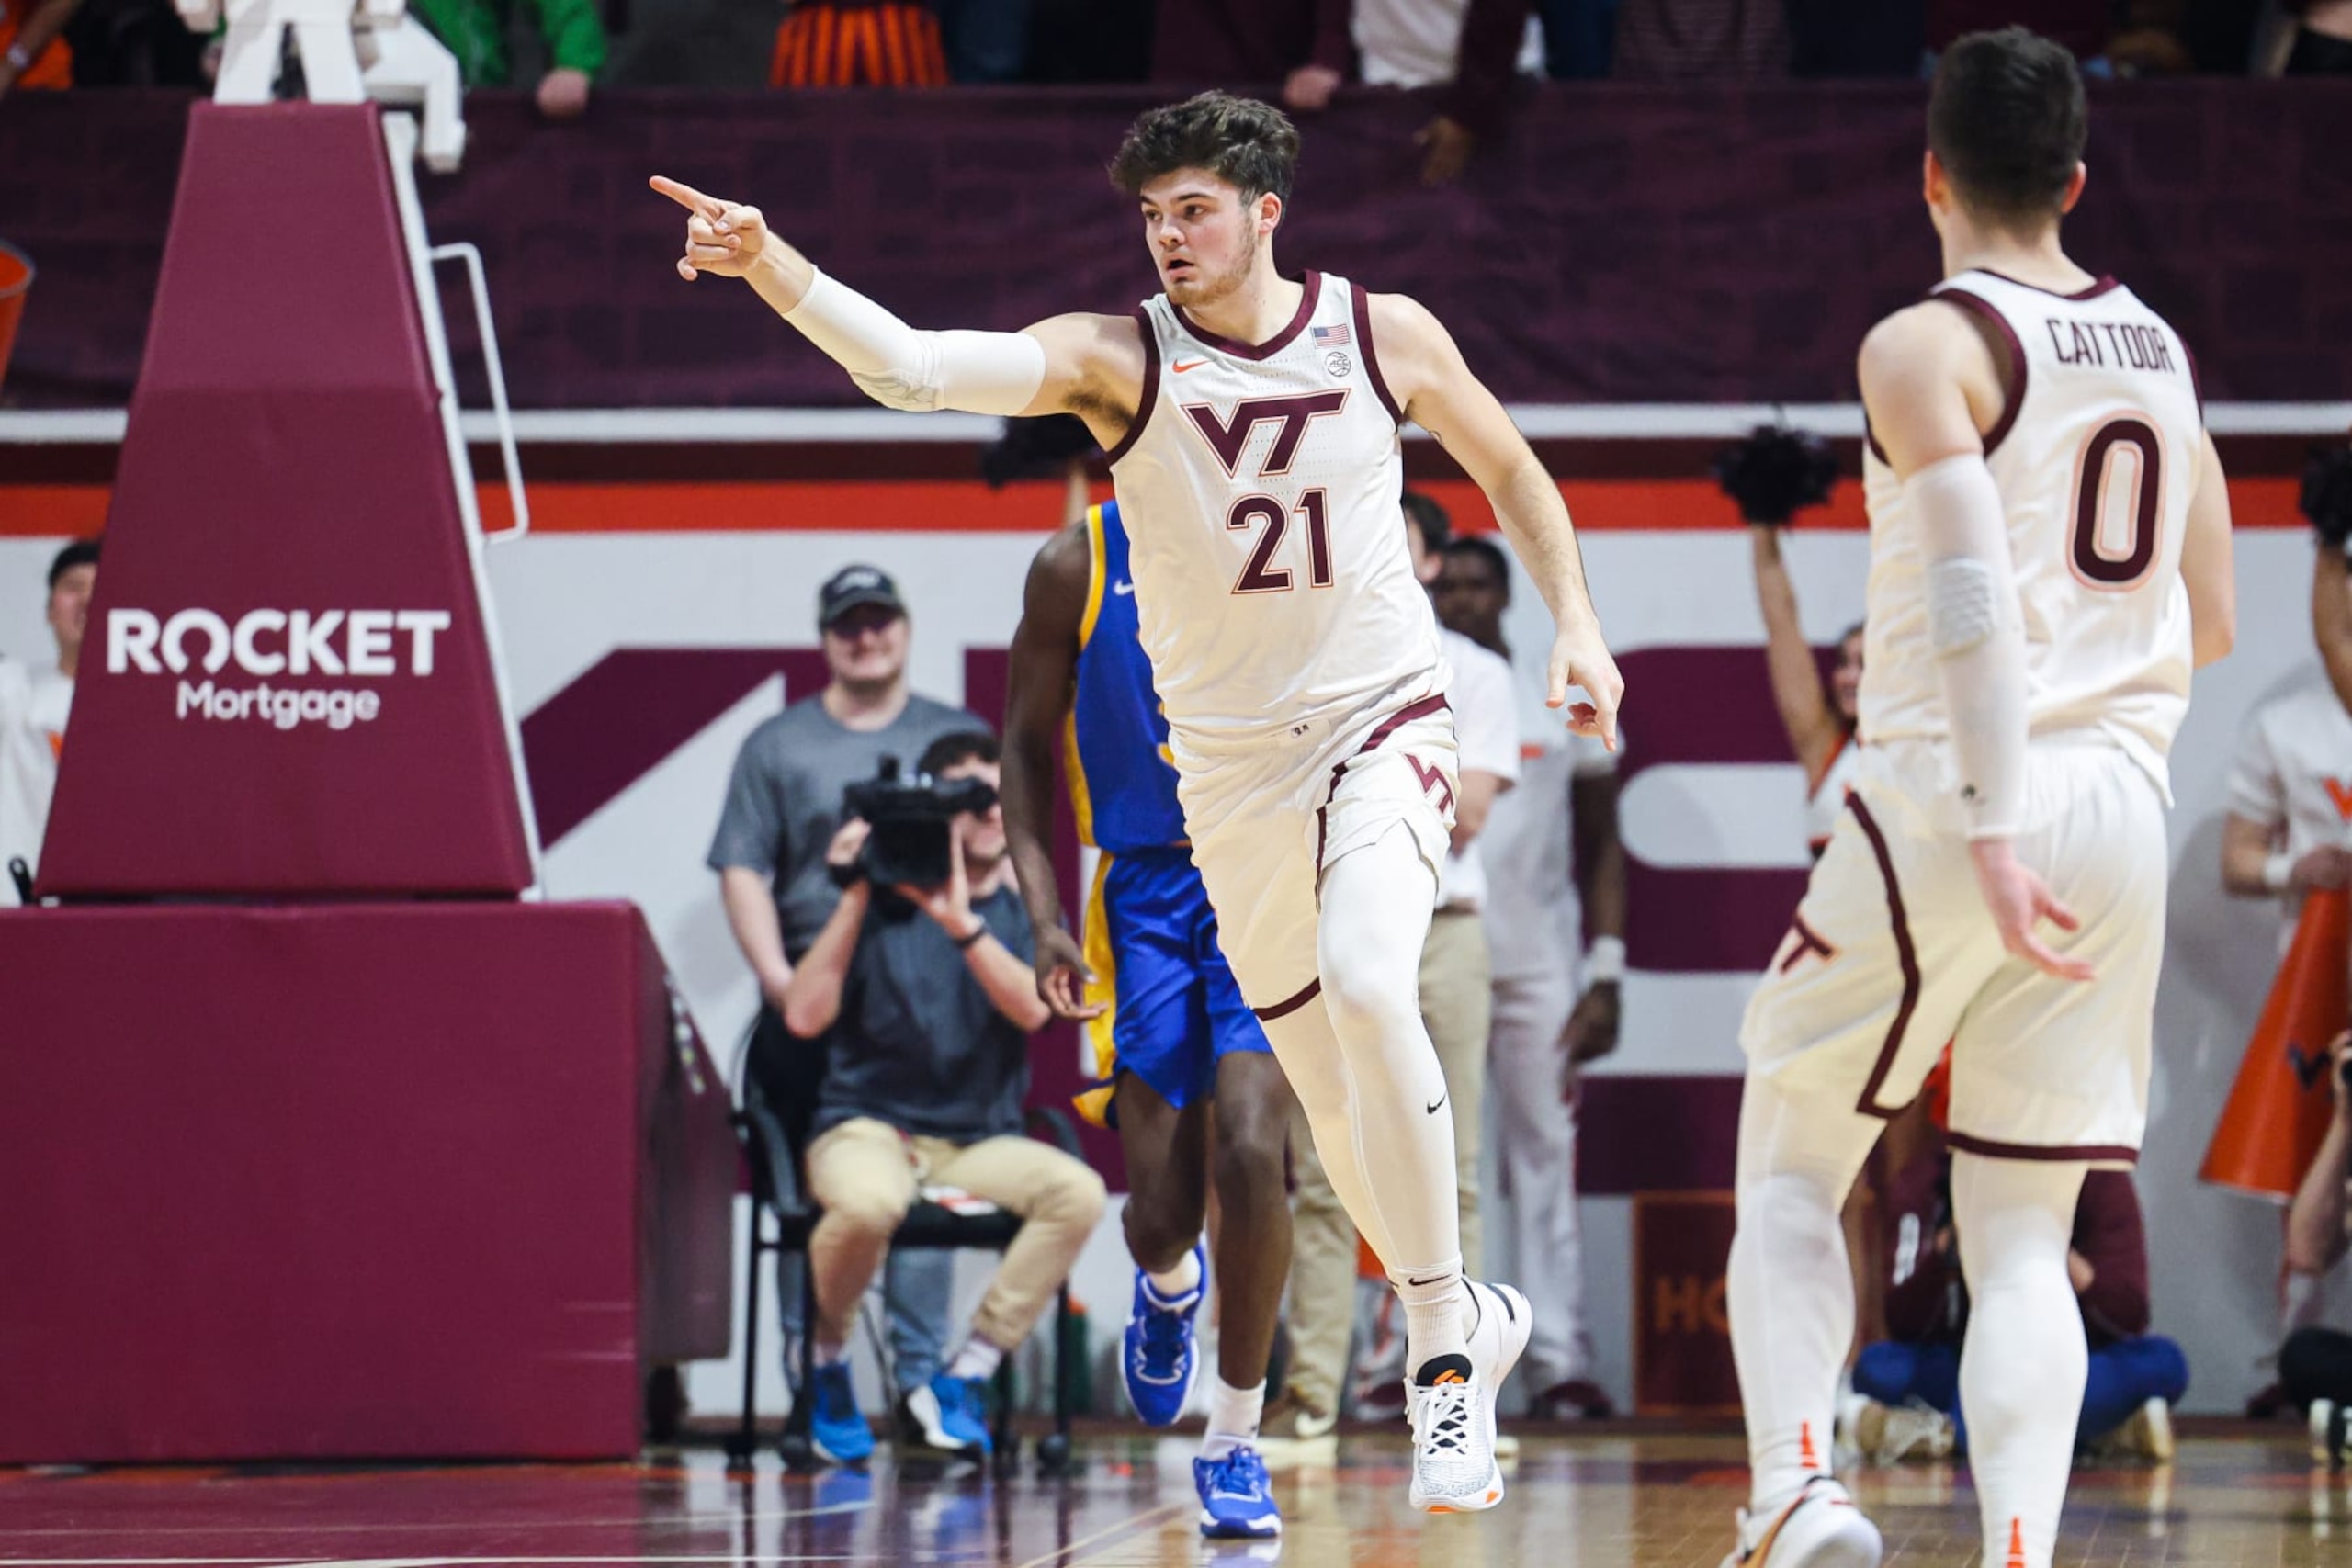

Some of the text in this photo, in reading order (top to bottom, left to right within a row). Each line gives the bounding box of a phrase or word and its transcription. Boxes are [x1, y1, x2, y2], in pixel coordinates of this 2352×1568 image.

[2046, 319, 2176, 373] CATTOOR
[1181, 388, 1351, 479] VT
[2066, 410, 2167, 592] 0
[1226, 487, 1334, 594] 21
[107, 609, 451, 675] ROCKET
[177, 681, 380, 729] Mortgage
